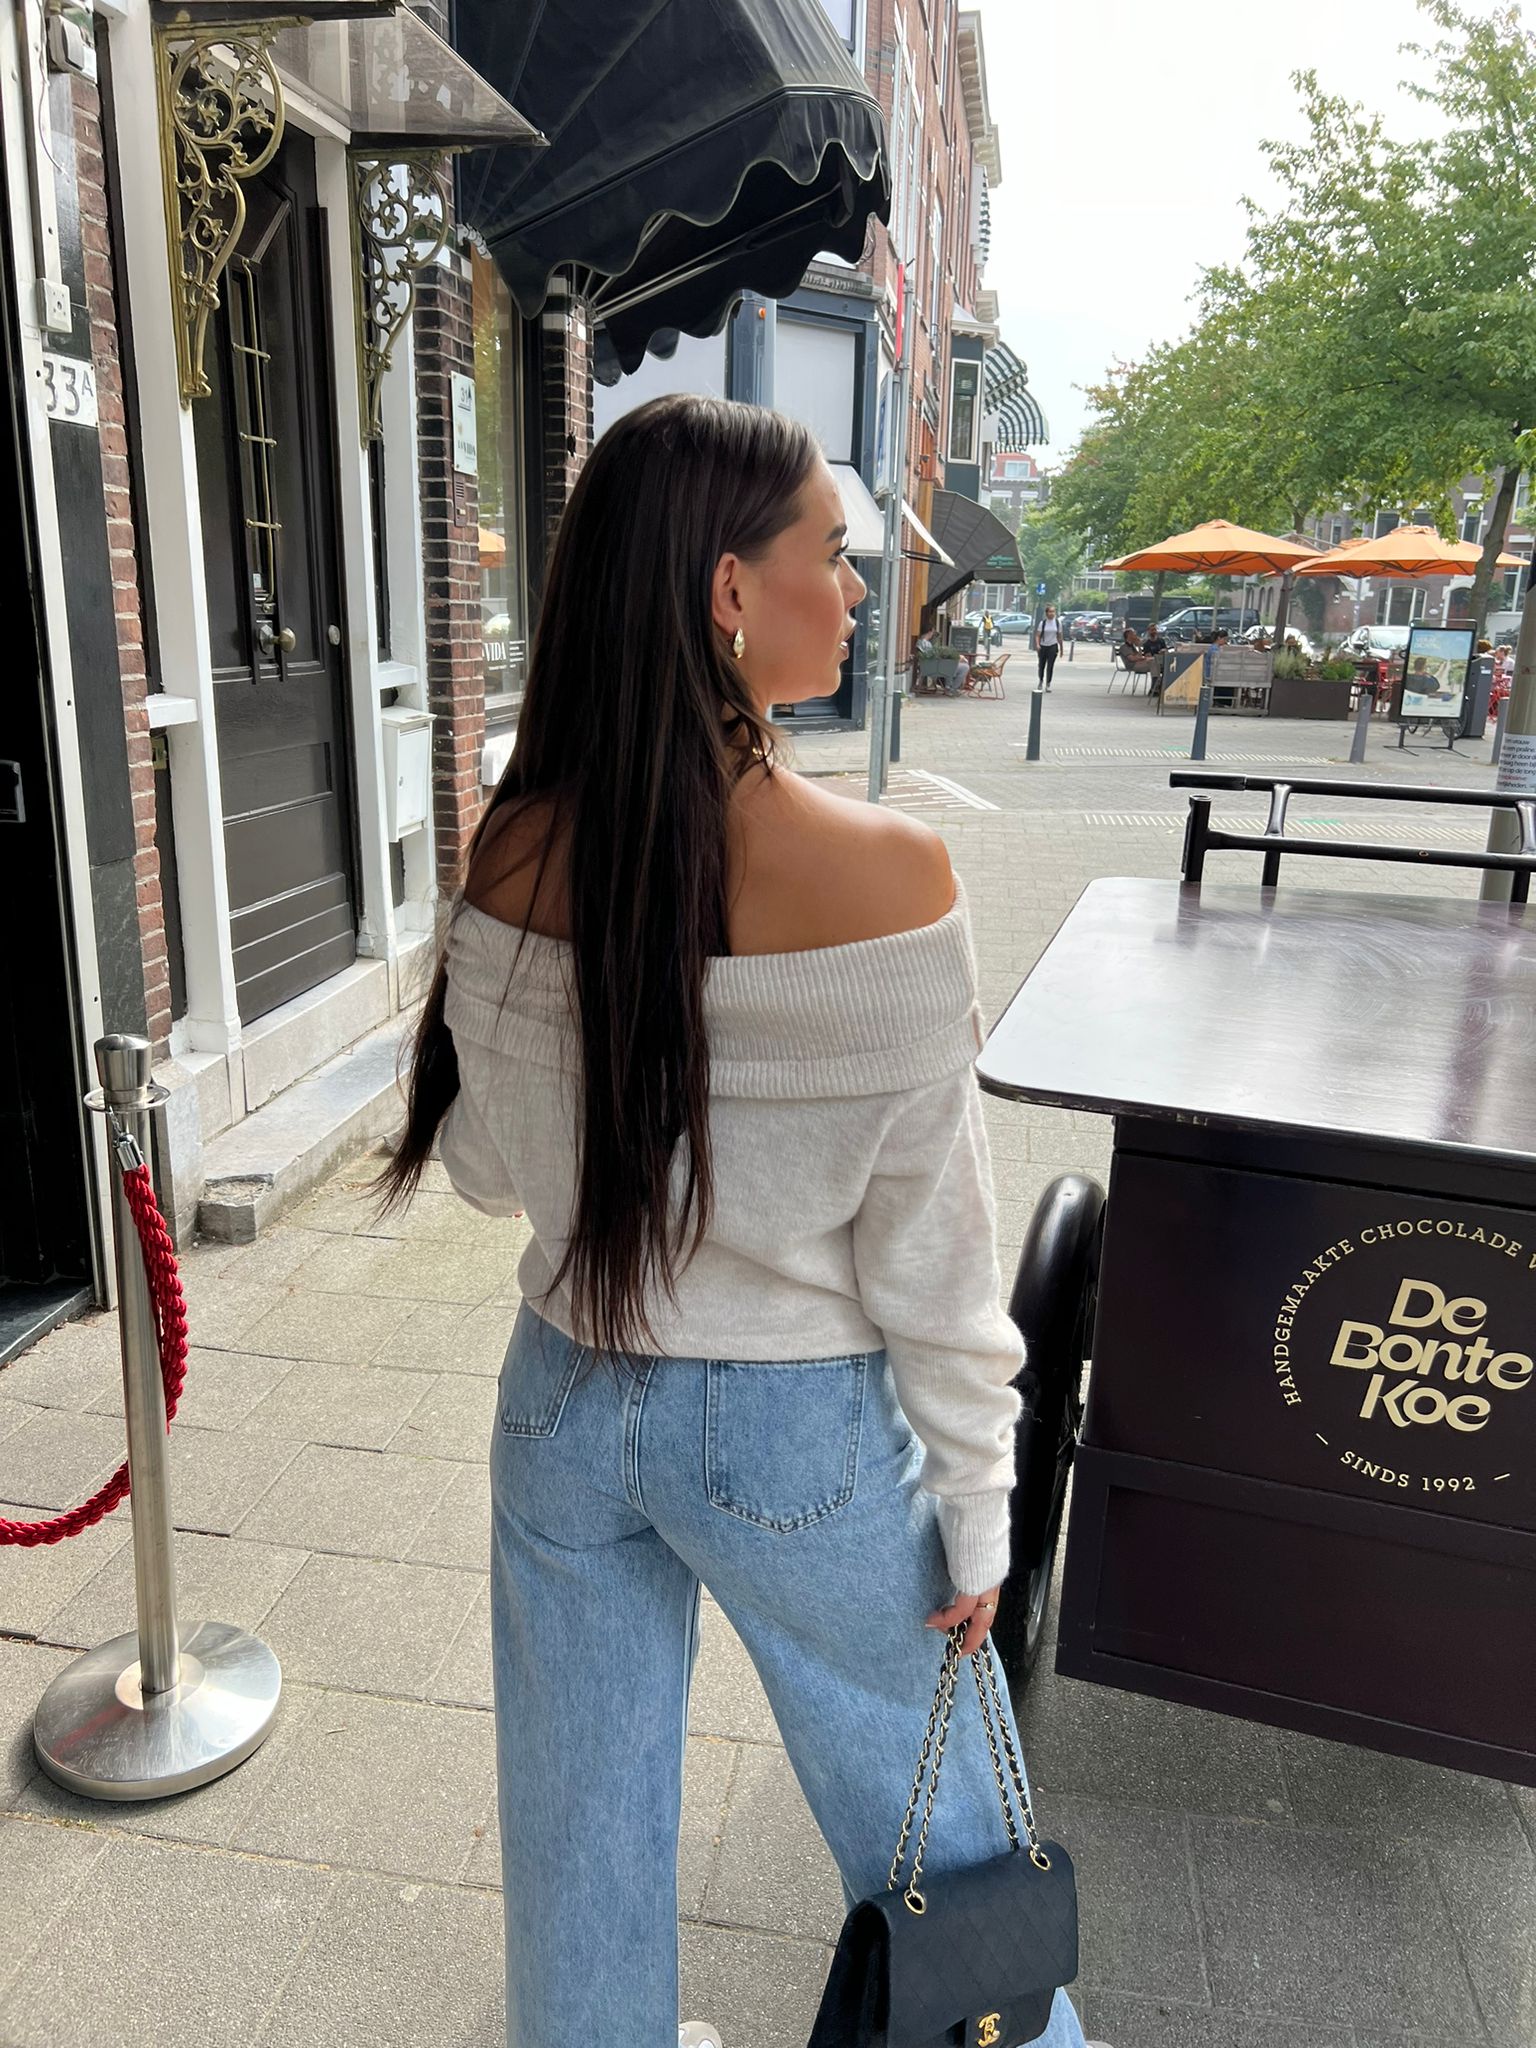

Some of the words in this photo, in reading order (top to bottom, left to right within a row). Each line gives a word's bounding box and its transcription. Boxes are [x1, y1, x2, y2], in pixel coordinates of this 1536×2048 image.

[1273, 1239, 1354, 1406] HANDGEMAAKTE
[1360, 1219, 1522, 1257] CHOCOLADE
[1388, 1278, 1487, 1335] De
[1329, 1320, 1533, 1390] Bonte
[1359, 1373, 1491, 1432] Koe
[1340, 1451, 1409, 1487] SINDS
[1422, 1477, 1475, 1492] 1992
